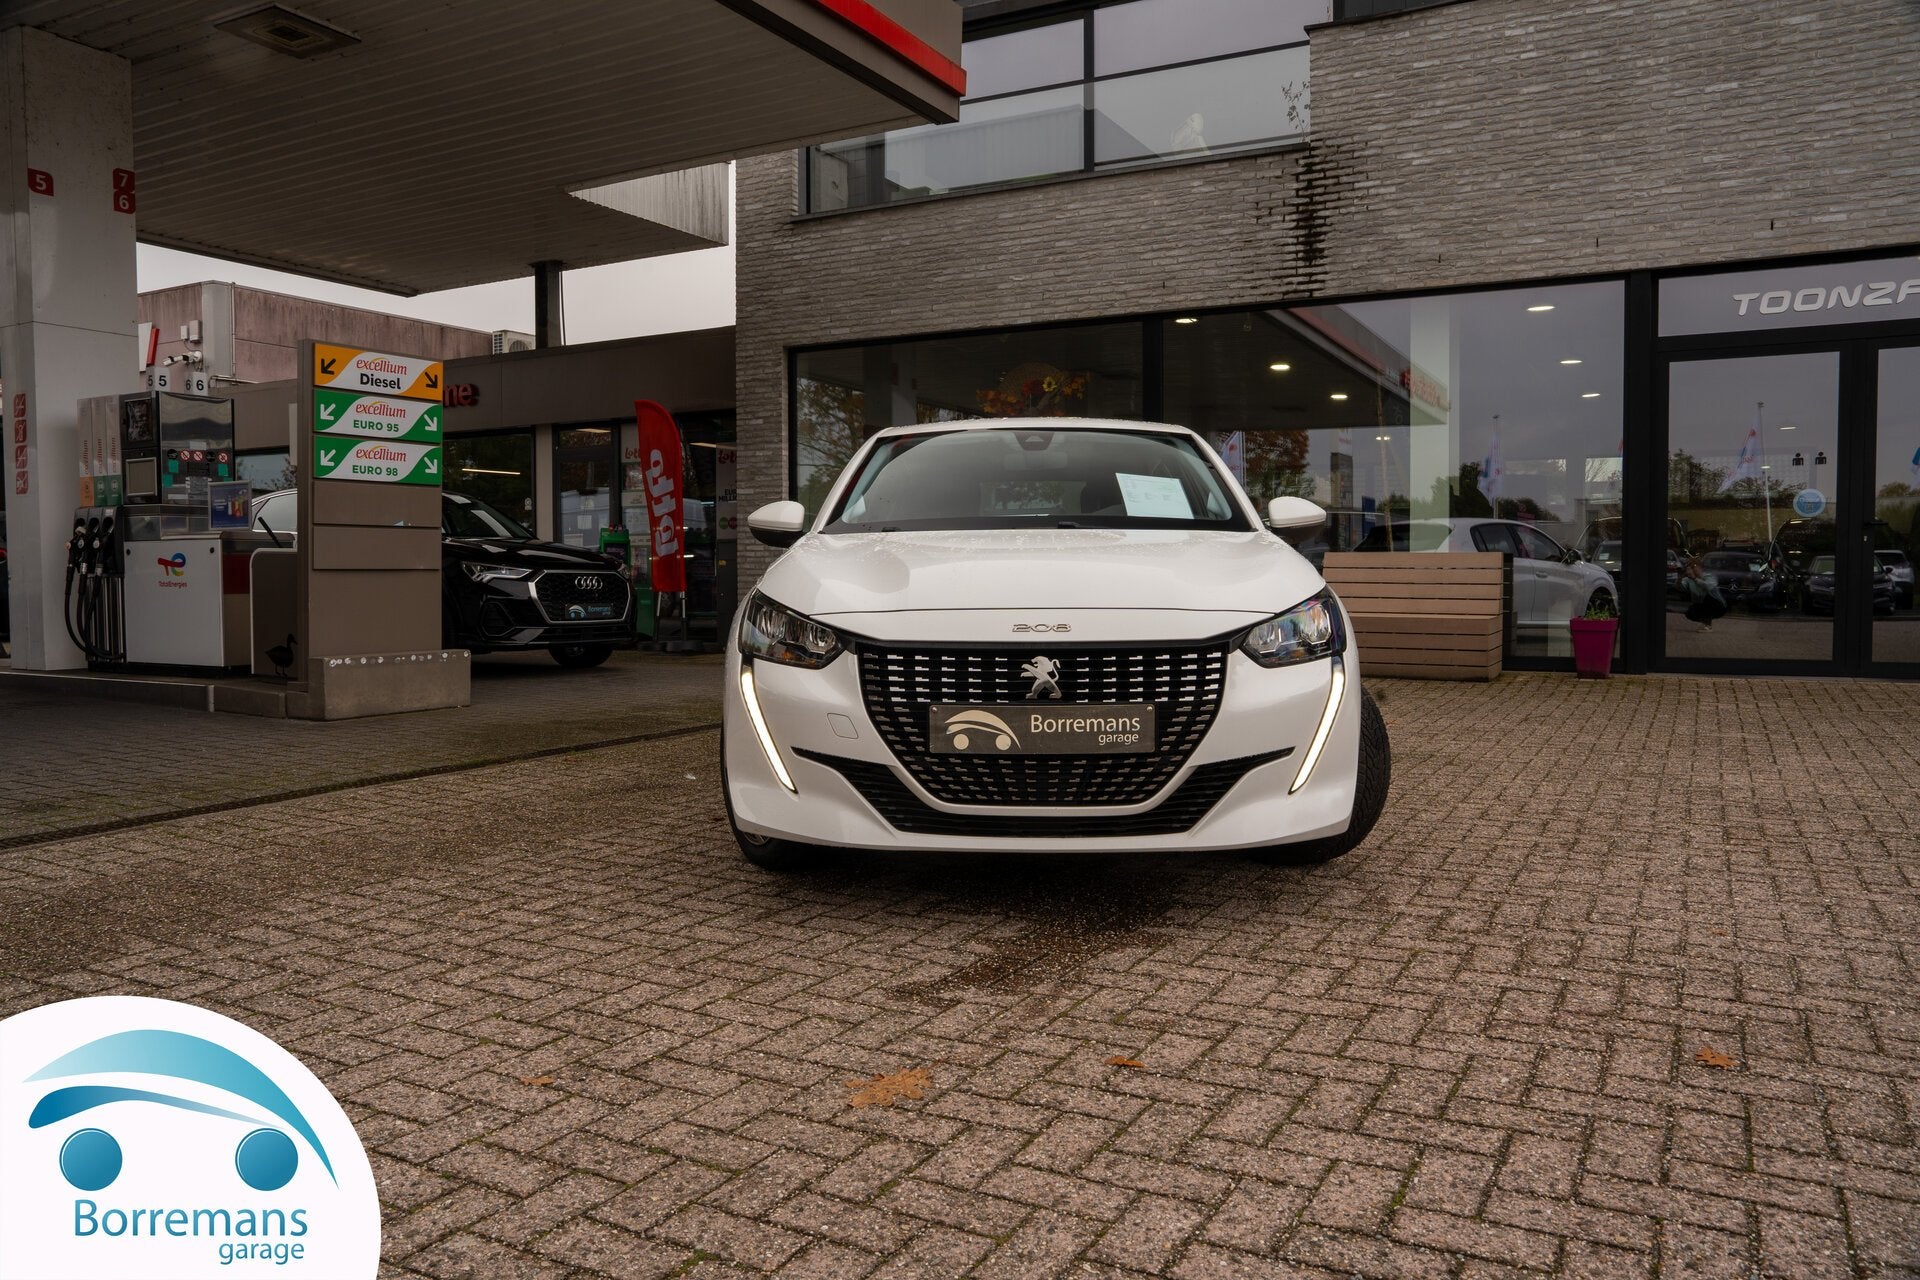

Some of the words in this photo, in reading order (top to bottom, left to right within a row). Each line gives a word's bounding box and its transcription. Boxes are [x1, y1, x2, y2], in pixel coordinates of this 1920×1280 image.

[35, 174, 47, 191] 5
[119, 173, 129, 188] 7
[118, 194, 129, 210] 6
[356, 358, 408, 376] excellium
[158, 375, 167, 387] 5
[196, 379, 204, 391] 6
[360, 373, 401, 390] Diesel
[355, 402, 406, 419] excellium
[353, 419, 383, 431] EURO
[386, 423, 400, 432] 95
[356, 446, 407, 462] excellium
[352, 465, 382, 475] EURO
[385, 467, 398, 476] 98
[1012, 623, 1073, 633] 208
[1030, 714, 1141, 733] Borremans
[1098, 733, 1139, 746] garage
